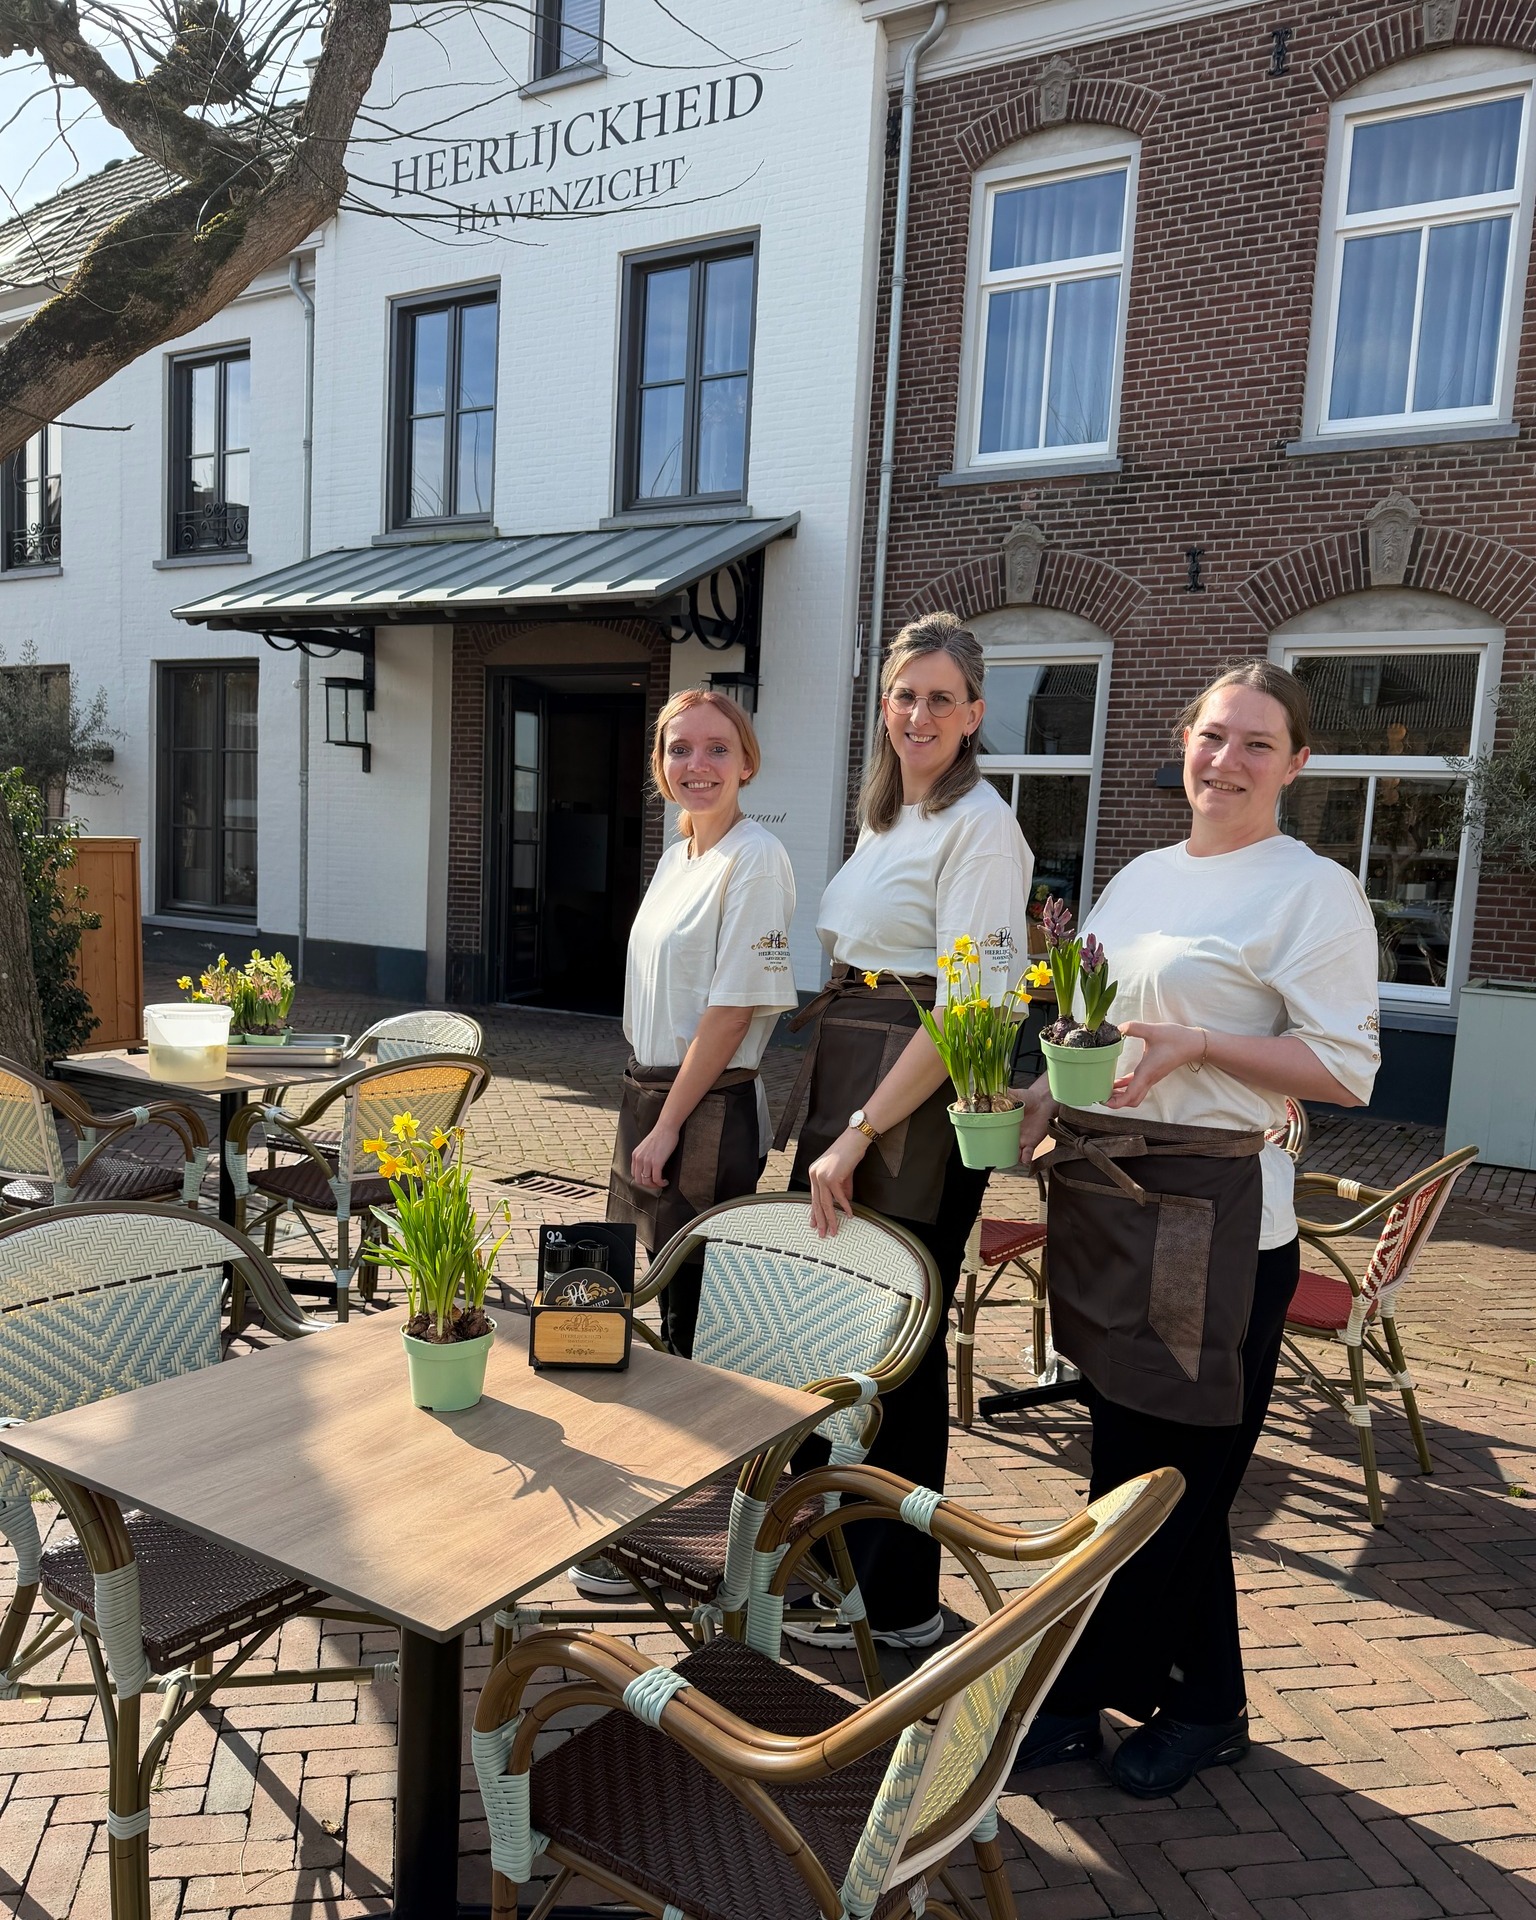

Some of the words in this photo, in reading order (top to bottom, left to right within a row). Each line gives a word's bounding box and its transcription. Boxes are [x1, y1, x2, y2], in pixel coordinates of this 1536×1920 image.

[391, 72, 764, 199] HEERLIJCKHEID
[454, 155, 687, 235] HAVENZICHT
[546, 1230, 567, 1243] 92
